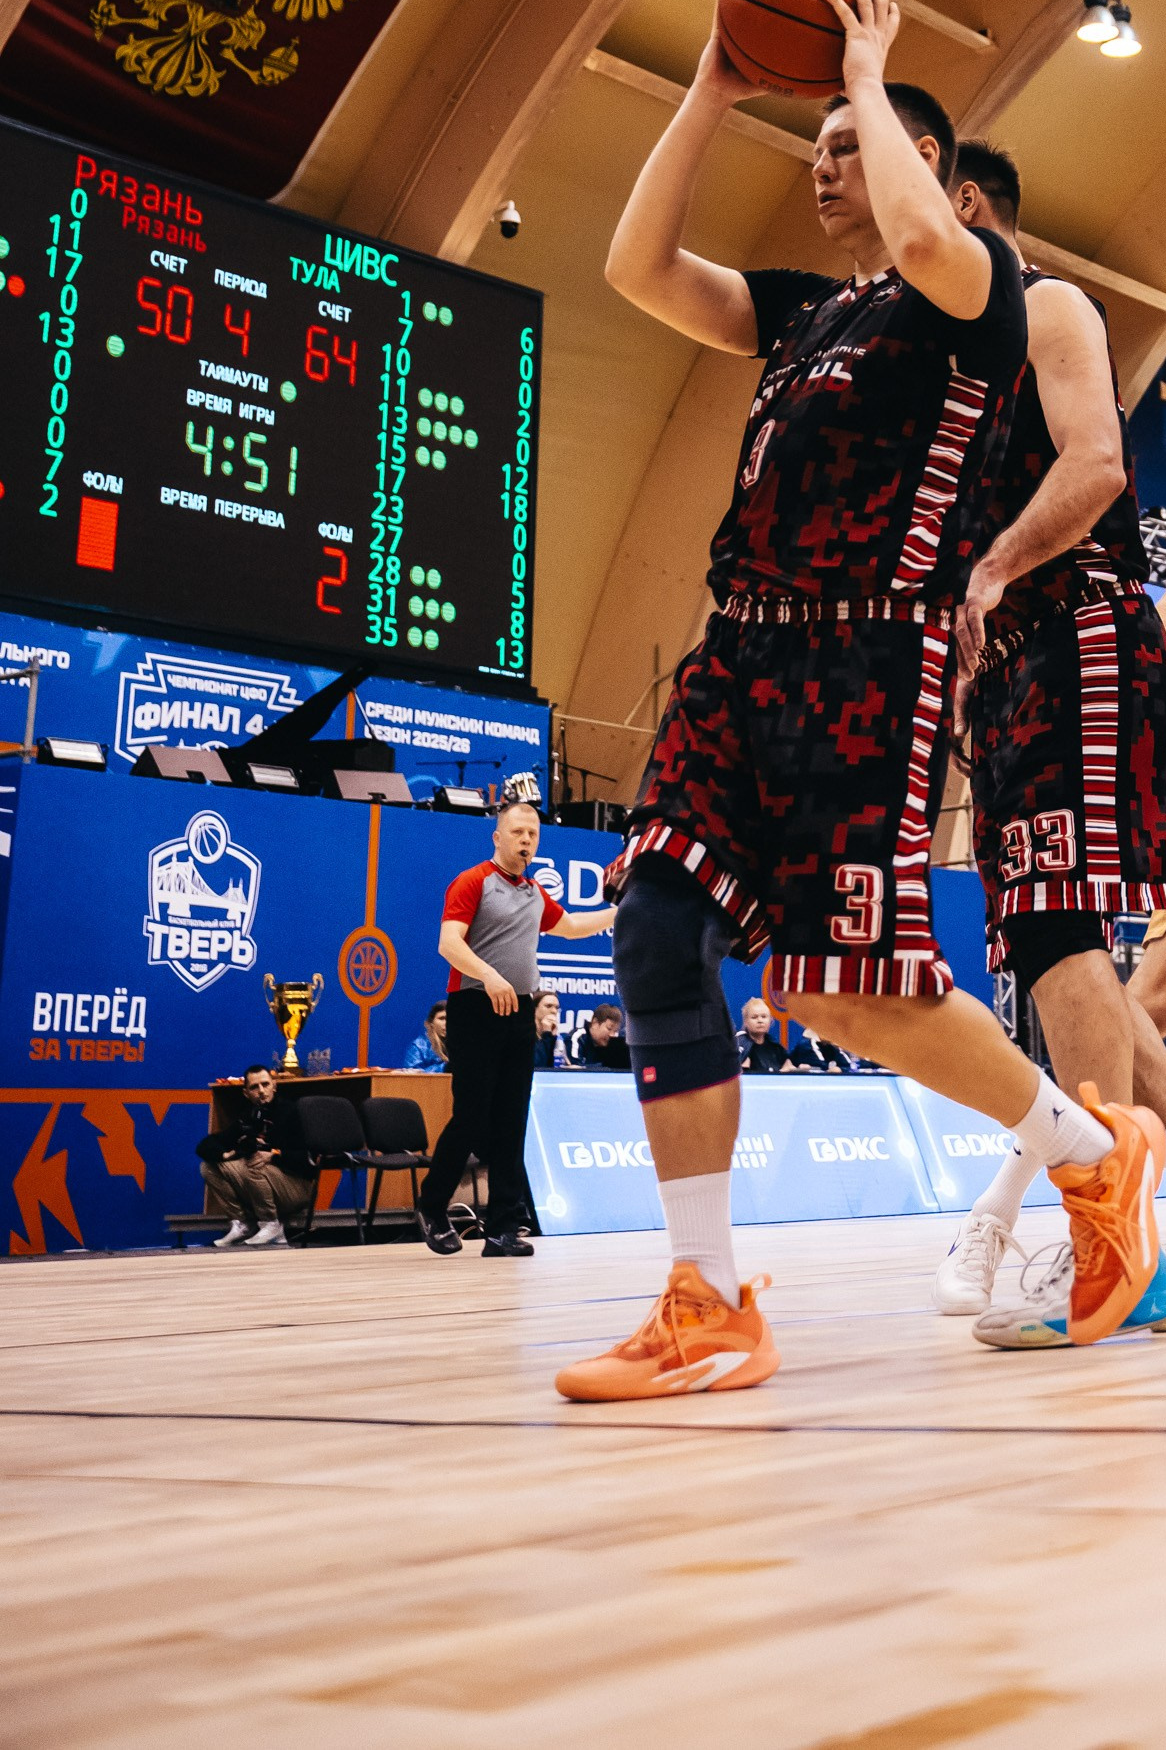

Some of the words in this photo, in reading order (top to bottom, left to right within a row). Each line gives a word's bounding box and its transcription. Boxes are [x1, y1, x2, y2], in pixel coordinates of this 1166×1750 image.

[71, 188, 88, 219] 0
[74, 153, 204, 227] Рязань
[49, 214, 81, 250] 11
[121, 205, 208, 253] Рязань
[46, 246, 83, 282] 17
[150, 250, 189, 275] СЧЕТ
[289, 256, 341, 294] ТУЛА
[323, 233, 400, 288] ЦИВС
[213, 268, 268, 299] ПЕРИОД
[60, 284, 78, 316] 0
[136, 276, 194, 345] 50
[318, 300, 352, 323] СЧЕТ
[401, 291, 411, 318] 1
[38, 312, 75, 348] 13
[224, 303, 251, 357] 4
[398, 317, 413, 346] 7
[521, 328, 534, 354] 6
[54, 350, 71, 381] 0
[304, 324, 358, 386] 64
[382, 343, 411, 376] 10
[520, 355, 533, 381] 0
[51, 382, 68, 415] 0
[380, 373, 406, 405] 11
[519, 382, 532, 409] 0
[186, 388, 232, 415] ВРЕМЯ
[238, 402, 275, 426] ИГРЫ
[378, 402, 408, 434] 13
[47, 416, 65, 448] 0
[517, 410, 530, 438] 2
[186, 421, 298, 496] 4:51
[377, 432, 406, 464] 15
[516, 438, 529, 467] 0
[739, 418, 776, 490] 3
[45, 448, 63, 481] 7
[375, 462, 405, 494] 17
[501, 463, 528, 495] 12
[82, 470, 123, 494] ФОЛЫ
[39, 483, 58, 517] 2
[160, 486, 208, 513] ВРЕМЯ
[214, 498, 286, 529] ПЕРЕРЫВА
[371, 492, 404, 524] 23
[500, 492, 528, 522] 18
[318, 521, 353, 543] ФОЛЫ
[370, 522, 403, 554] 27
[513, 524, 527, 551] 0
[315, 546, 348, 615] 2
[368, 552, 401, 585] 28
[512, 553, 526, 580] 0
[367, 583, 396, 616] 31
[511, 581, 525, 609] 5
[365, 614, 399, 647] 35
[510, 611, 524, 639] 8
[496, 638, 524, 668] 13
[167, 674, 239, 697] ЧЕМПИОНАТ
[240, 686, 268, 702] ЦФО
[134, 700, 241, 735] ФИНАЛ
[365, 701, 413, 724] СРЕДИ
[414, 709, 484, 735] МУЖСКИХ
[484, 721, 541, 746] КОМАНД
[412, 730, 471, 754] 2025/26
[1001, 809, 1077, 882] 33
[830, 863, 884, 944] 3
[147, 921, 254, 966] ТВЕРЬ
[33, 987, 147, 1038] ВПЕРЁД
[29, 1038, 61, 1061] ЗА
[66, 1039, 146, 1063] ТВЕРЬ!
[591, 1140, 655, 1168] DKC
[834, 1136, 890, 1162] DKC
[966, 1133, 1013, 1157] DKC
